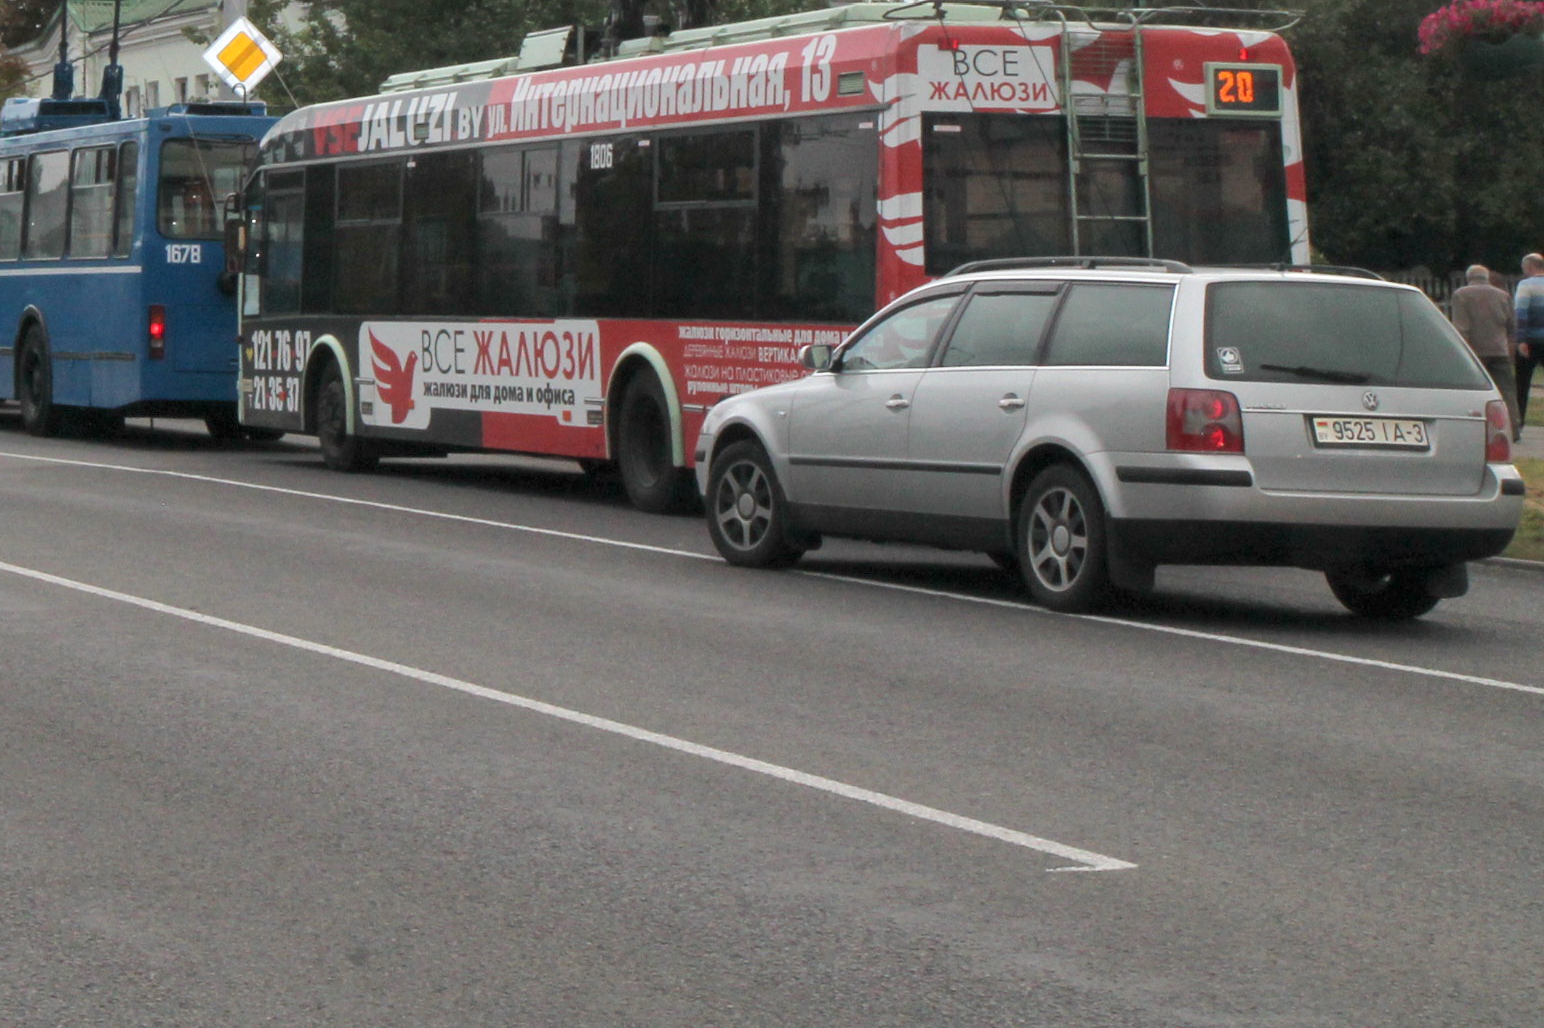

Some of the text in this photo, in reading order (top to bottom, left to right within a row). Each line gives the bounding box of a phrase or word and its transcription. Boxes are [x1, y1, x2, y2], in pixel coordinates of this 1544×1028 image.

[953, 49, 1018, 76] ВСЕ
[509, 51, 791, 133] Интернациональная,
[801, 34, 837, 103] 13
[929, 81, 1047, 101] ЖАЛЮЗИ
[1218, 70, 1254, 102] 20
[590, 143, 613, 169] 1806
[165, 244, 202, 264] 1678
[794, 329, 813, 345] для
[814, 330, 840, 345] дома
[421, 328, 594, 380] ВСЕ ЖАЛЮЗИ
[423, 381, 575, 410] жалюзи для дома и офиса
[1332, 421, 1376, 441] 9525
